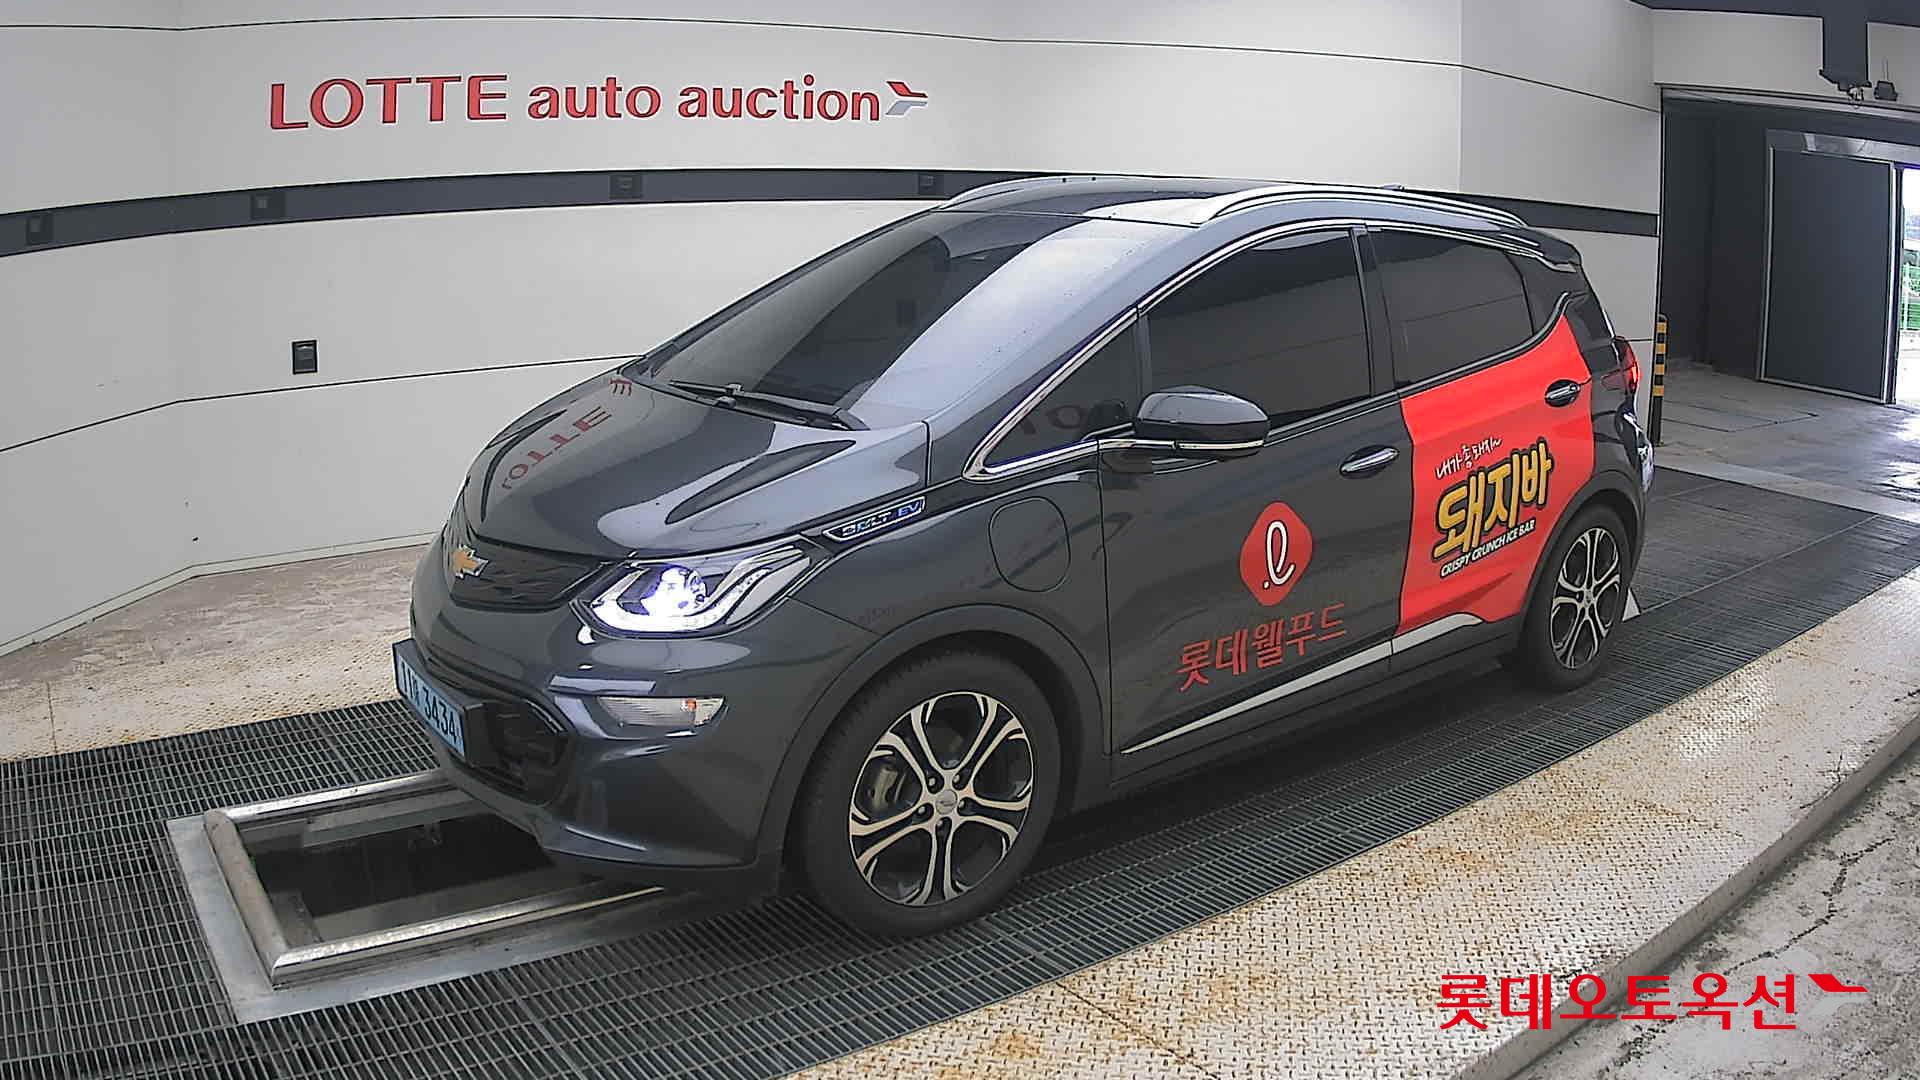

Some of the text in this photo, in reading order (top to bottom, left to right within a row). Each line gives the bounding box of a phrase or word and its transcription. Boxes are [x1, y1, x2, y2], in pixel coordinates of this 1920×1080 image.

[269, 74, 880, 130] LOTTE auto auction
[897, 500, 920, 518] EV
[1433, 438, 1553, 560] 돼지바
[1440, 518, 1537, 577] CRISPY CRUNCH ICE BAR
[1177, 602, 1347, 692] 롯데웰푸드
[422, 686, 457, 744] 3434
